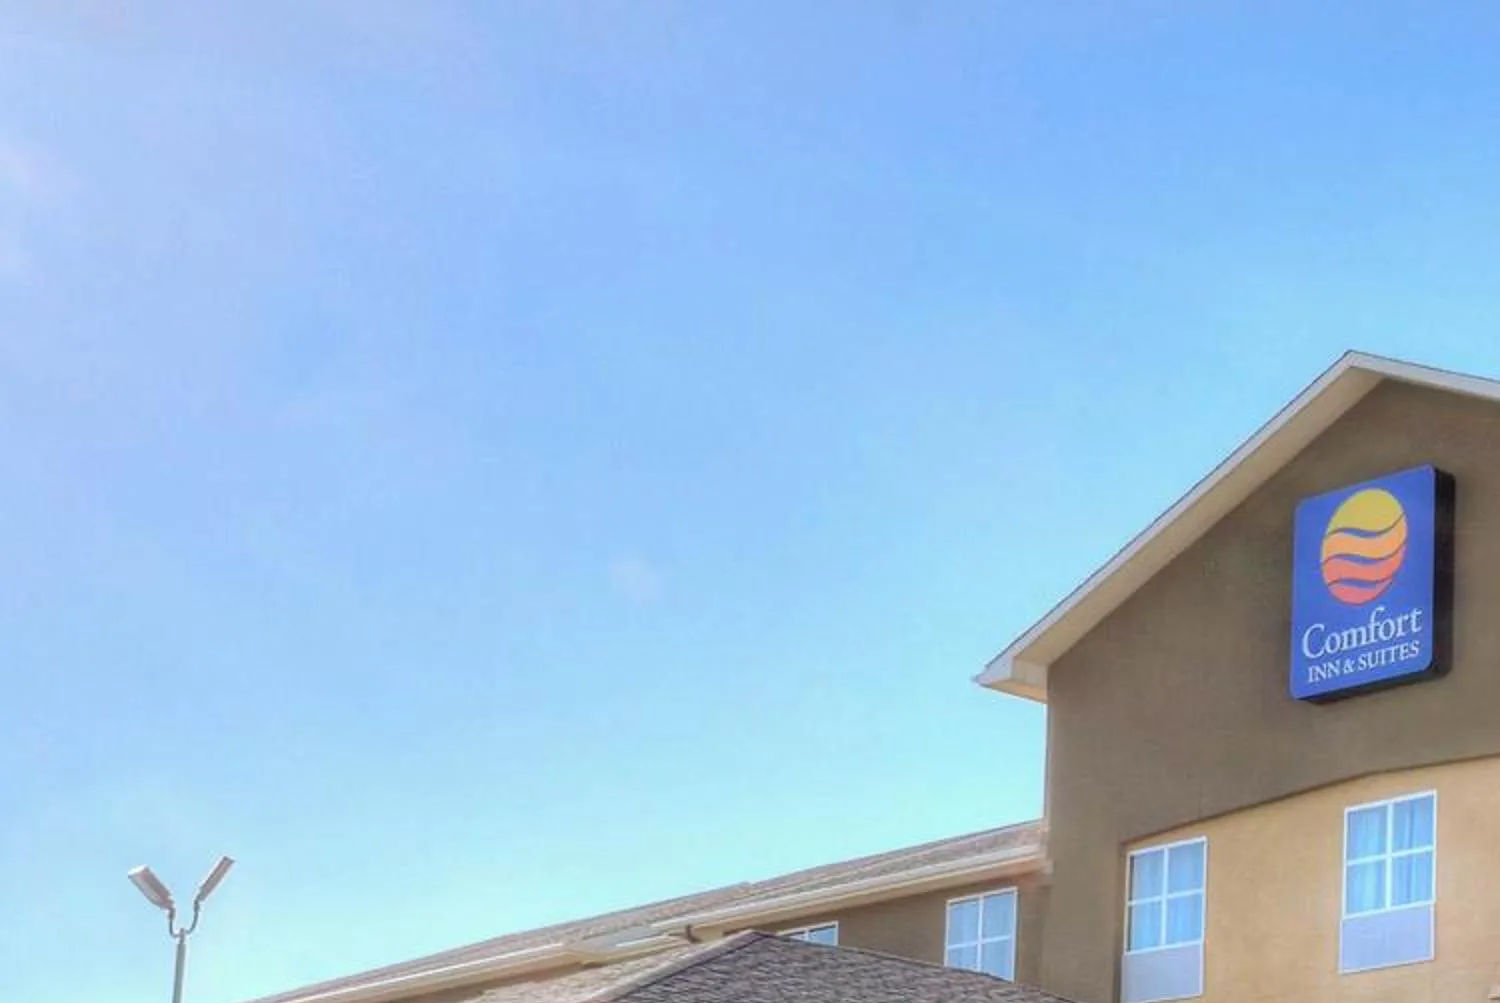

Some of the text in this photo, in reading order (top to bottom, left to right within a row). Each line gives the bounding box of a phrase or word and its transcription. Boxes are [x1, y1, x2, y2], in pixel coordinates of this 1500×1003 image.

[1302, 606, 1422, 659] Comfort
[1308, 640, 1420, 683] INN & SUITES
